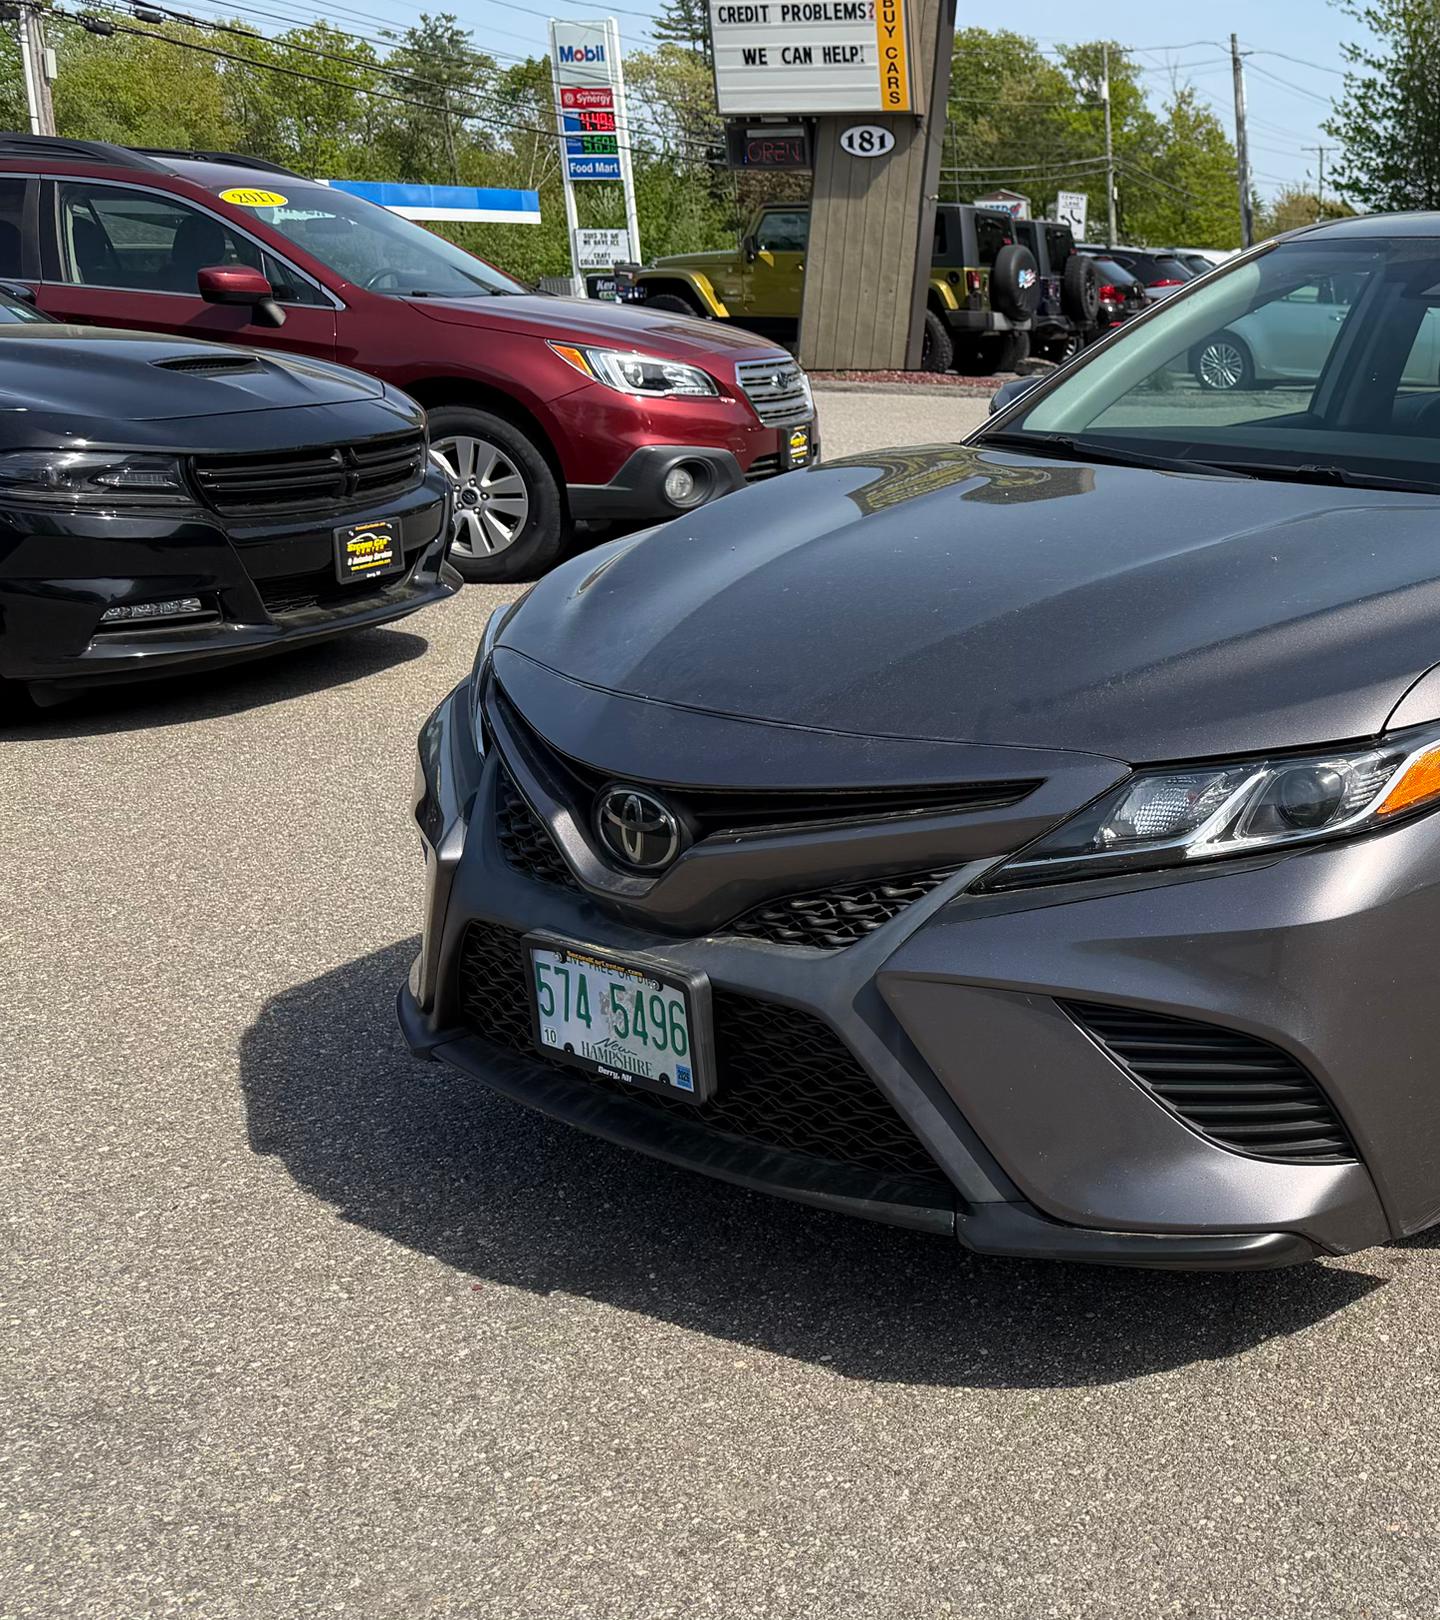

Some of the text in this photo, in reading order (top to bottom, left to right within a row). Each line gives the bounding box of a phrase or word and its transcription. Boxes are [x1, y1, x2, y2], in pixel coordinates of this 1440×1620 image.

[718, 2, 875, 23] CREDIT PROBLEMS?
[559, 45, 605, 62] Mobil
[742, 45, 865, 65] WE CAN HELP!
[885, 47, 901, 104] CARS
[576, 93, 611, 106] Synergy
[846, 130, 887, 152] 181
[747, 141, 800, 161] OPEN
[570, 161, 618, 173] Food Mart
[232, 193, 275, 203] 2017
[536, 962, 688, 1057] 574 5496
[545, 1028, 557, 1043] 10
[593, 1037, 638, 1056] New
[581, 1041, 653, 1078] HAMPSHIRE
[598, 1065, 632, 1083] Derry, NH
